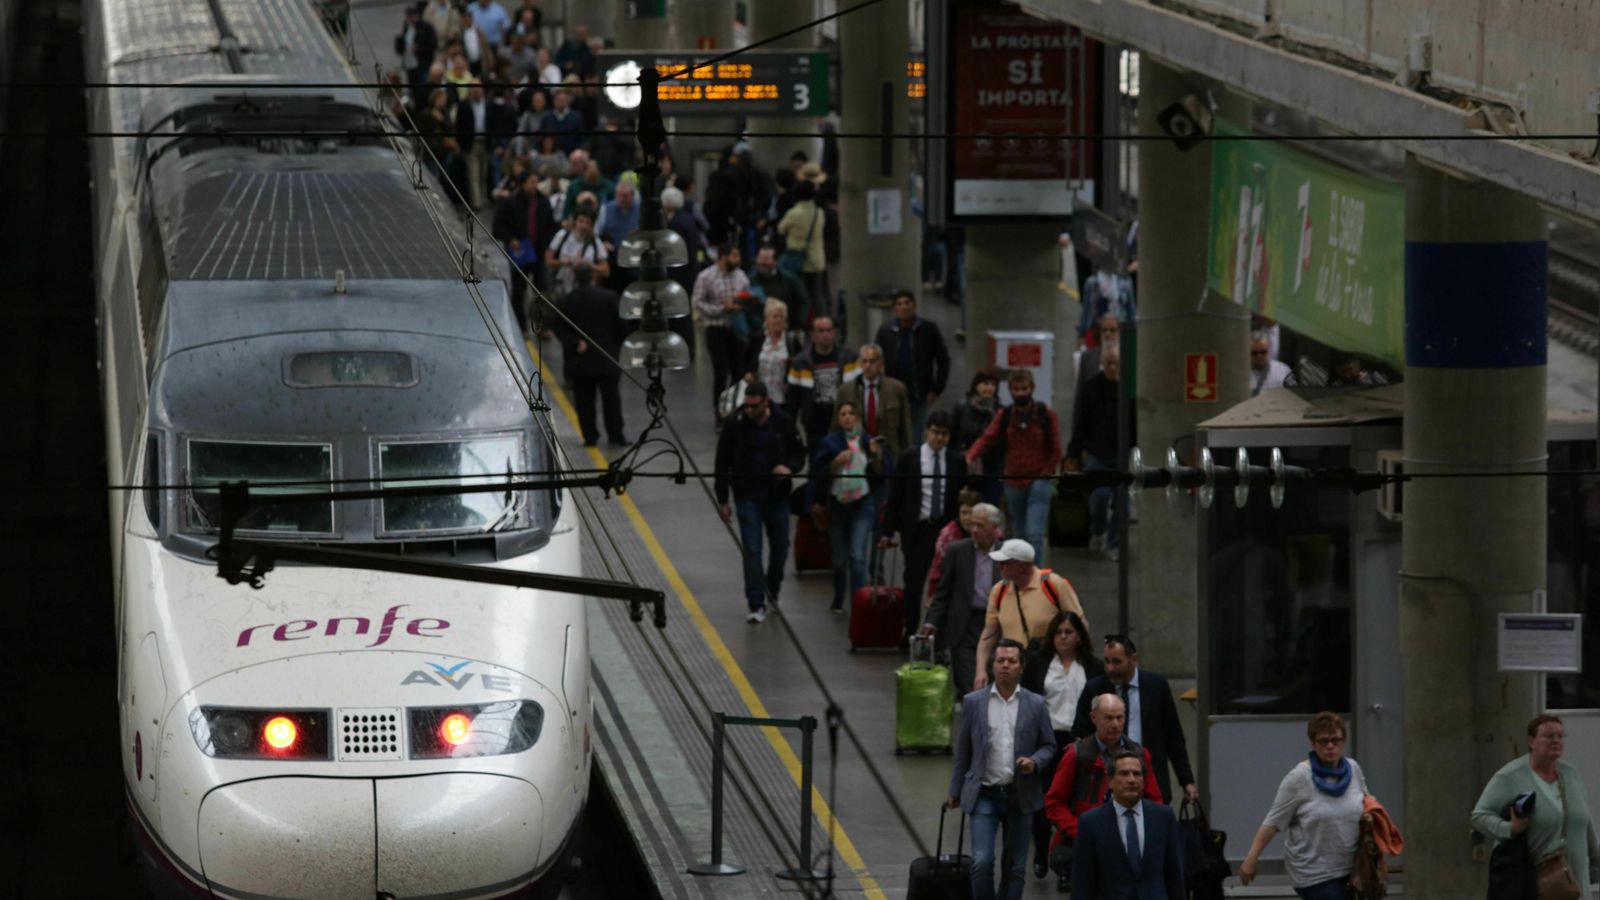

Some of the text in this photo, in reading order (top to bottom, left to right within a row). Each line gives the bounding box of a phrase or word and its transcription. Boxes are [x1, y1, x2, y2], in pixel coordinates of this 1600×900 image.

[971, 33, 1081, 49] LA PRÓSTATA
[1008, 52, 1043, 85] SÍ
[793, 83, 810, 111] 3
[978, 89, 1074, 106] IMPORTA
[1328, 190, 1339, 247] EL
[236, 603, 451, 648] renfe
[400, 661, 513, 692] AVE
